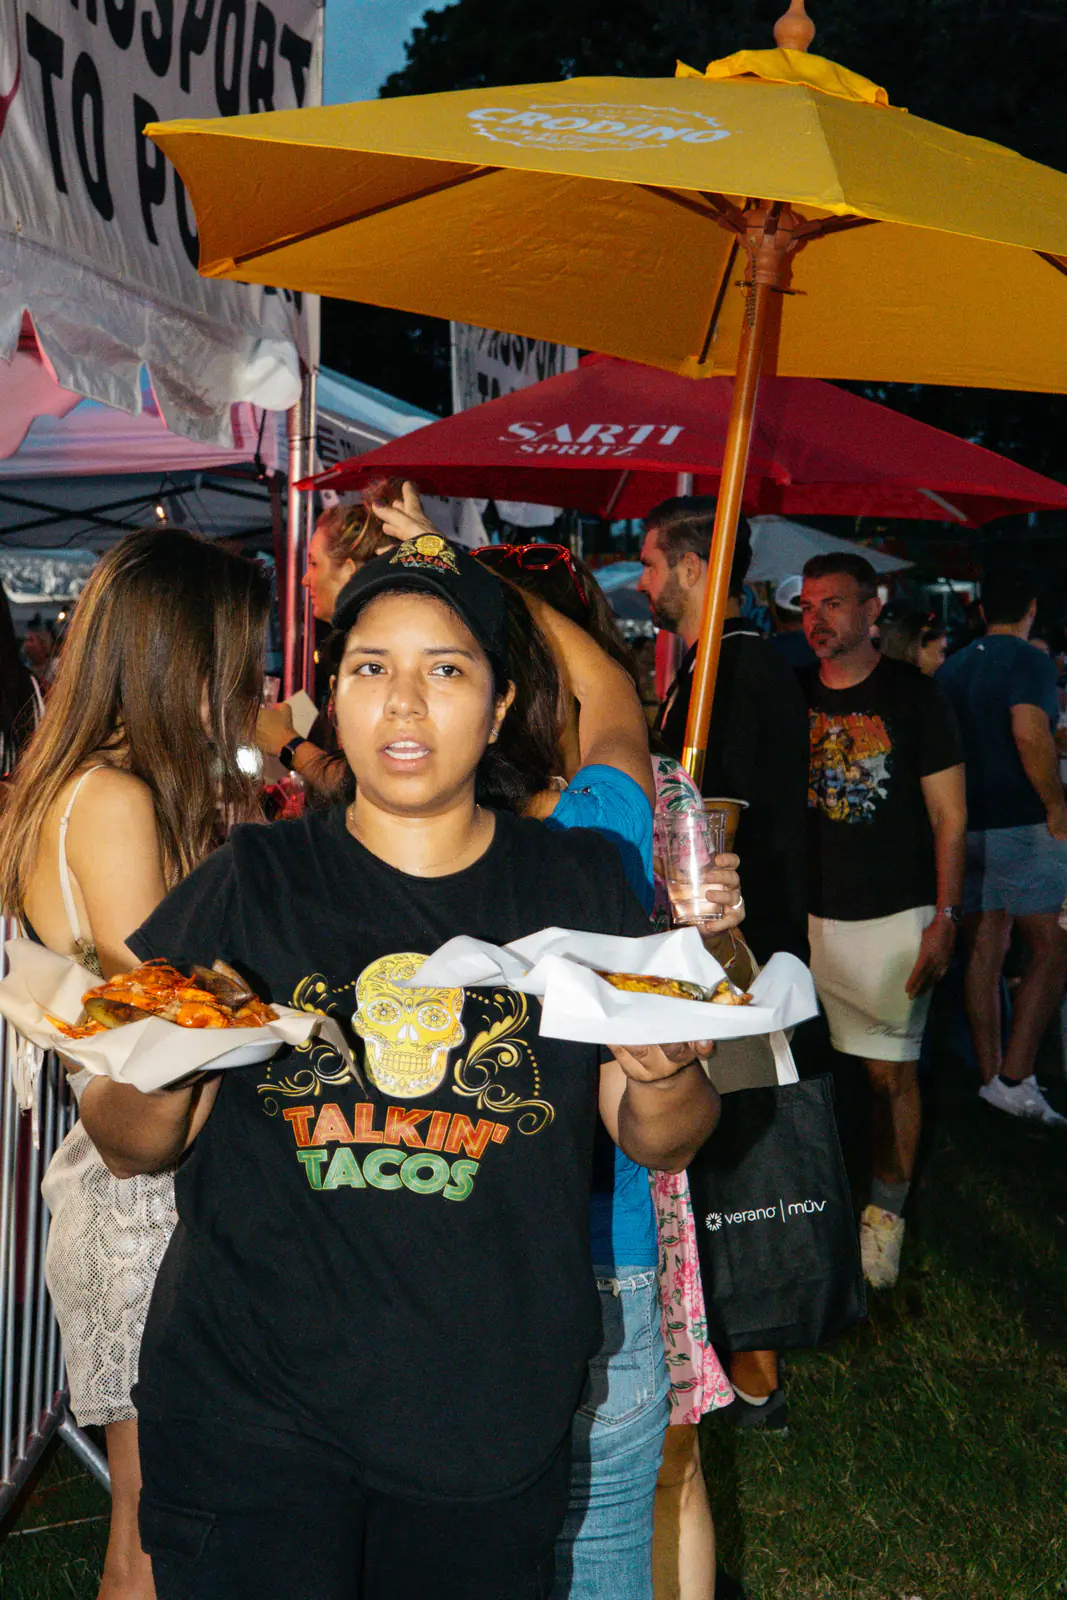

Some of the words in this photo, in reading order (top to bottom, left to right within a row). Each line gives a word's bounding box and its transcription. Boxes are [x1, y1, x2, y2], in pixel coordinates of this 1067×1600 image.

[70, 0, 313, 118] SPORT
[26, 12, 115, 222] TO
[467, 107, 731, 144] CRODINO
[498, 421, 685, 446] SARTI
[515, 443, 637, 456] SPRITZ
[282, 1102, 510, 1159] TALKIN'
[297, 1147, 479, 1201] TACOS
[724, 1206, 776, 1225] verano
[788, 1199, 827, 1215] müv
